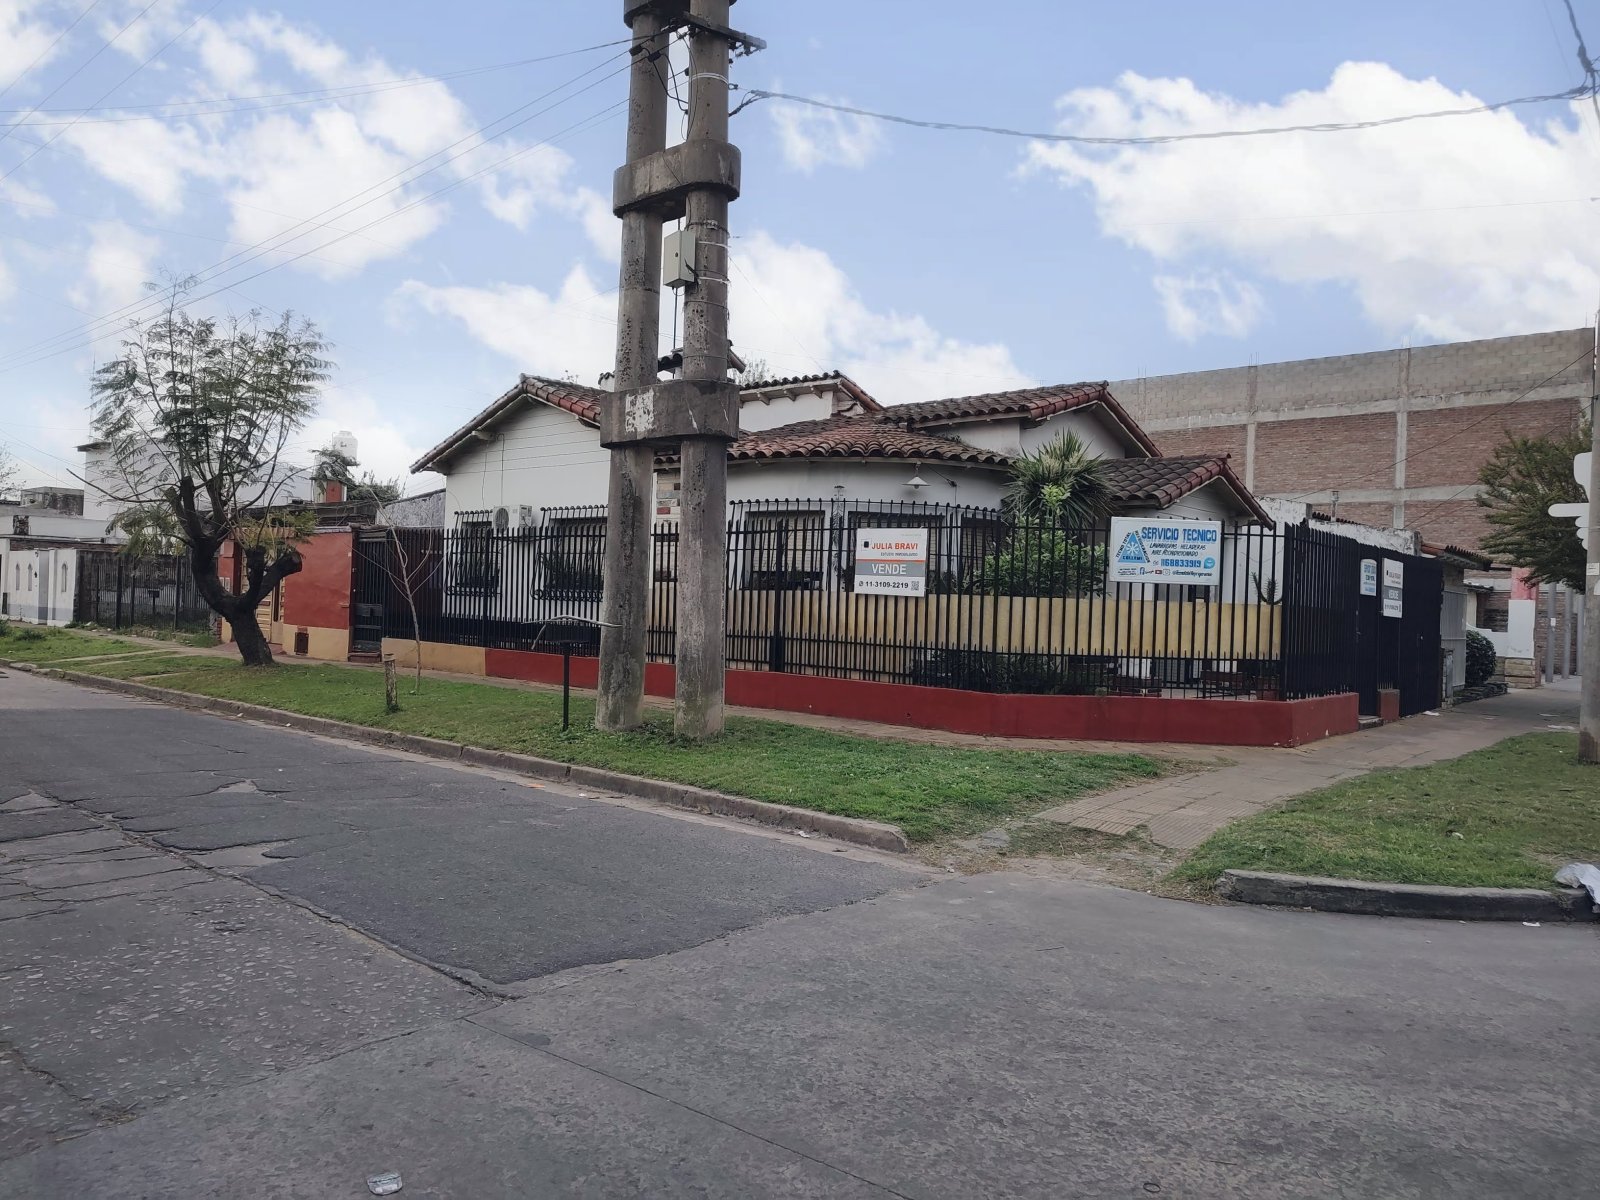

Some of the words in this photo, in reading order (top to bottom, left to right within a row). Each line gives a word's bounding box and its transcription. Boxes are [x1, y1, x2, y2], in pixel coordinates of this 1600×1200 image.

[1141, 527, 1179, 540] SERVICIO
[1183, 528, 1217, 542] TECNICO
[871, 563, 907, 575] VENDE
[866, 581, 909, 589] 11-3109-2219
